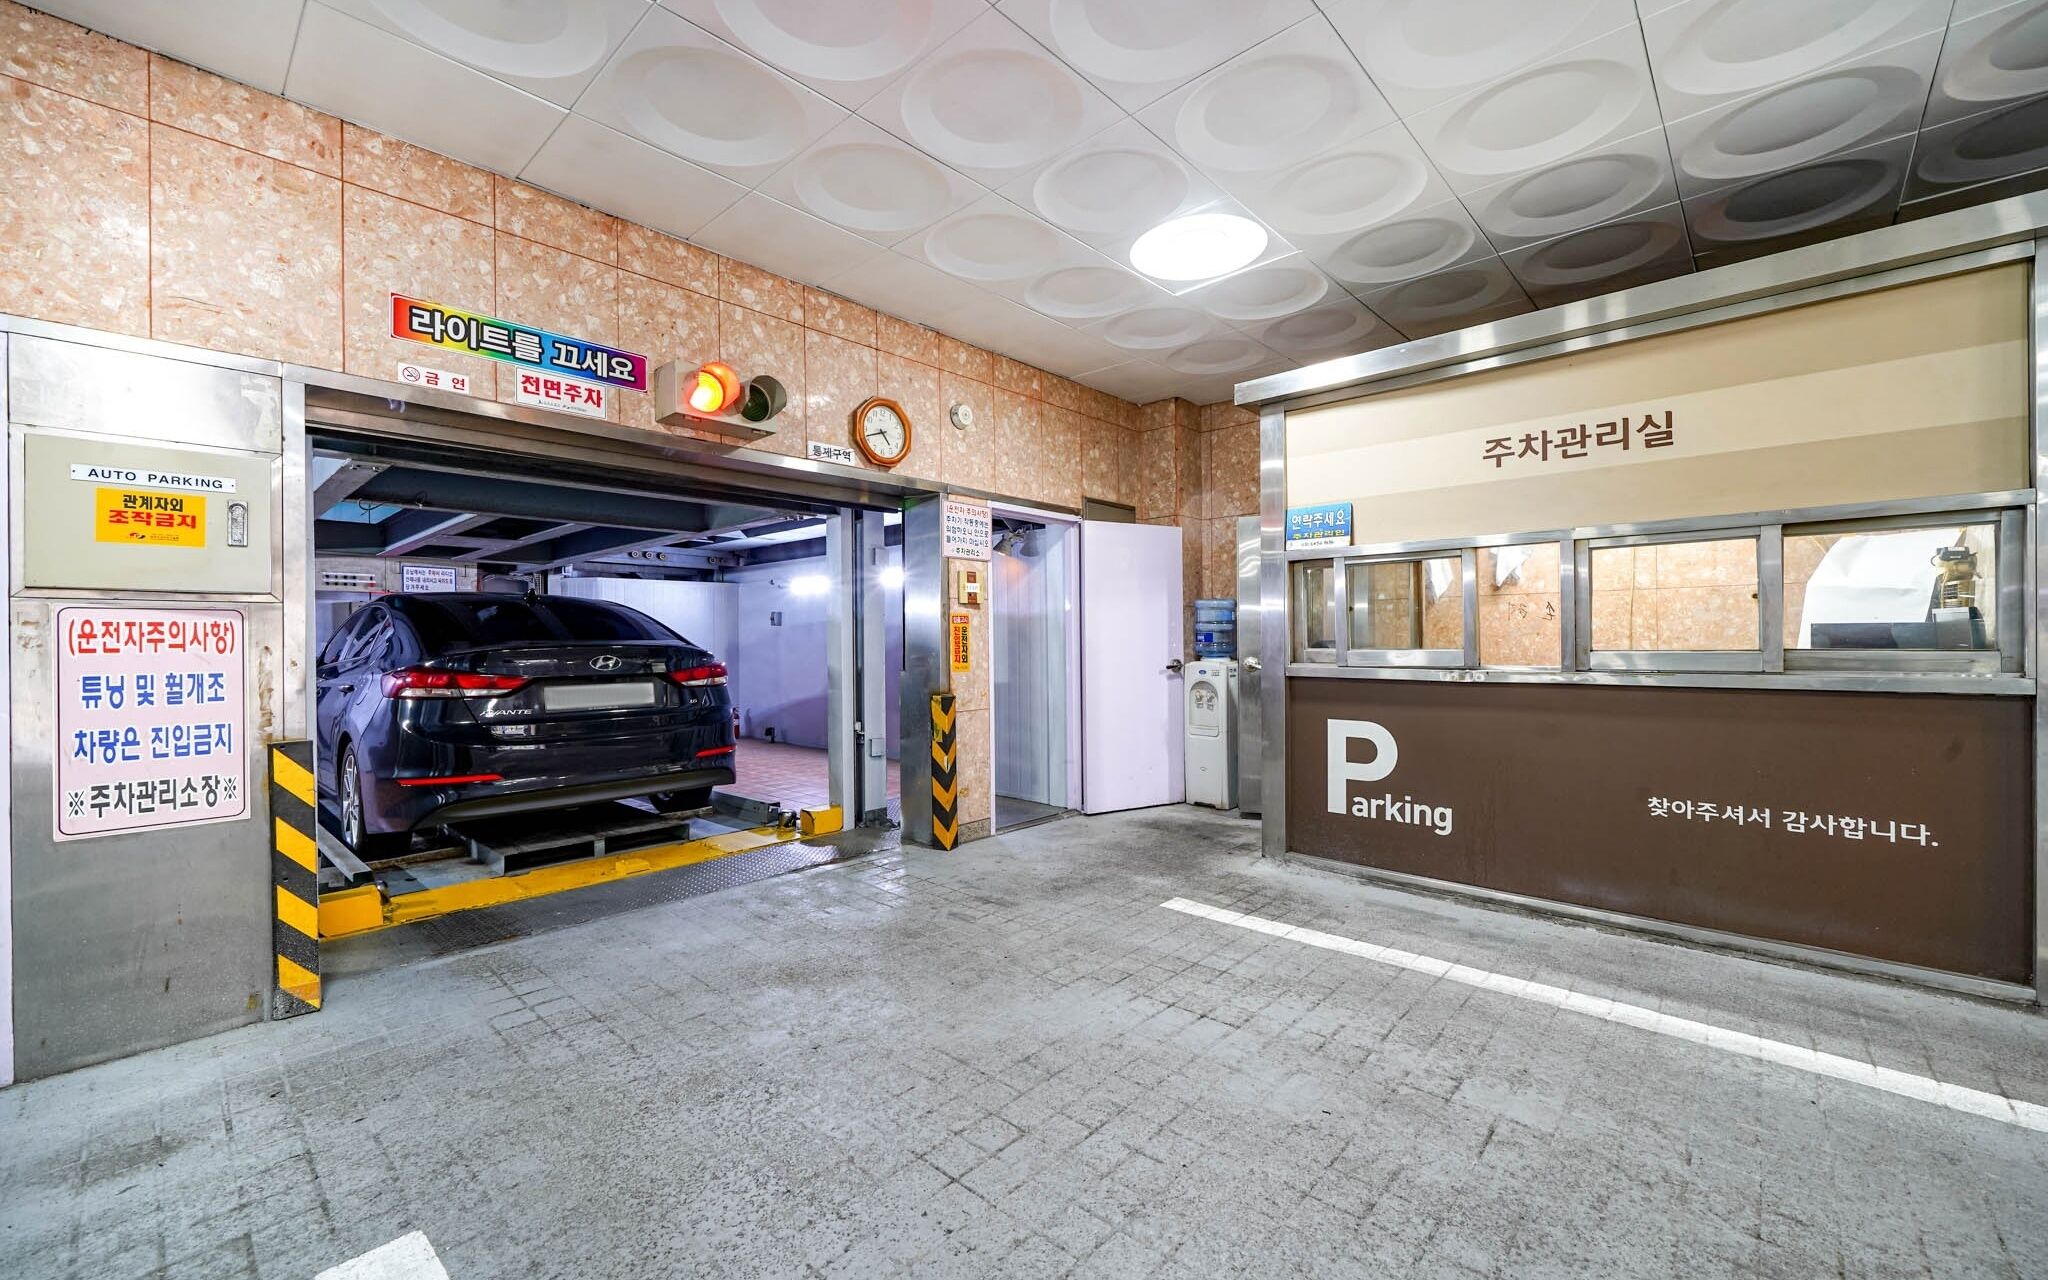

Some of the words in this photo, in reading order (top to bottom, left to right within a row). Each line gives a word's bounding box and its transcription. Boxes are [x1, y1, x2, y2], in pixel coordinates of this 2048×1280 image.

[410, 307, 542, 364] 라이트를
[552, 341, 636, 382] 끄세요
[521, 374, 604, 408] 전면주차
[812, 444, 852, 463] 통제구역
[1482, 410, 1675, 468] 주차관리실
[88, 468, 137, 481] AUTO
[148, 474, 223, 489] PARKING
[109, 509, 197, 529] 조작금지
[123, 494, 184, 513] 관계자외
[1291, 510, 1346, 530] 연락주세요
[68, 618, 235, 656] (운전자주의사항)
[81, 675, 125, 709] 튜닝
[136, 674, 155, 707] 및
[165, 672, 225, 706] 휠개조
[74, 727, 141, 764] 차량은
[151, 723, 232, 759] 진입금지
[1647, 796, 1772, 829] 찾아주셔서
[1781, 809, 1940, 847] 감사합니다.
